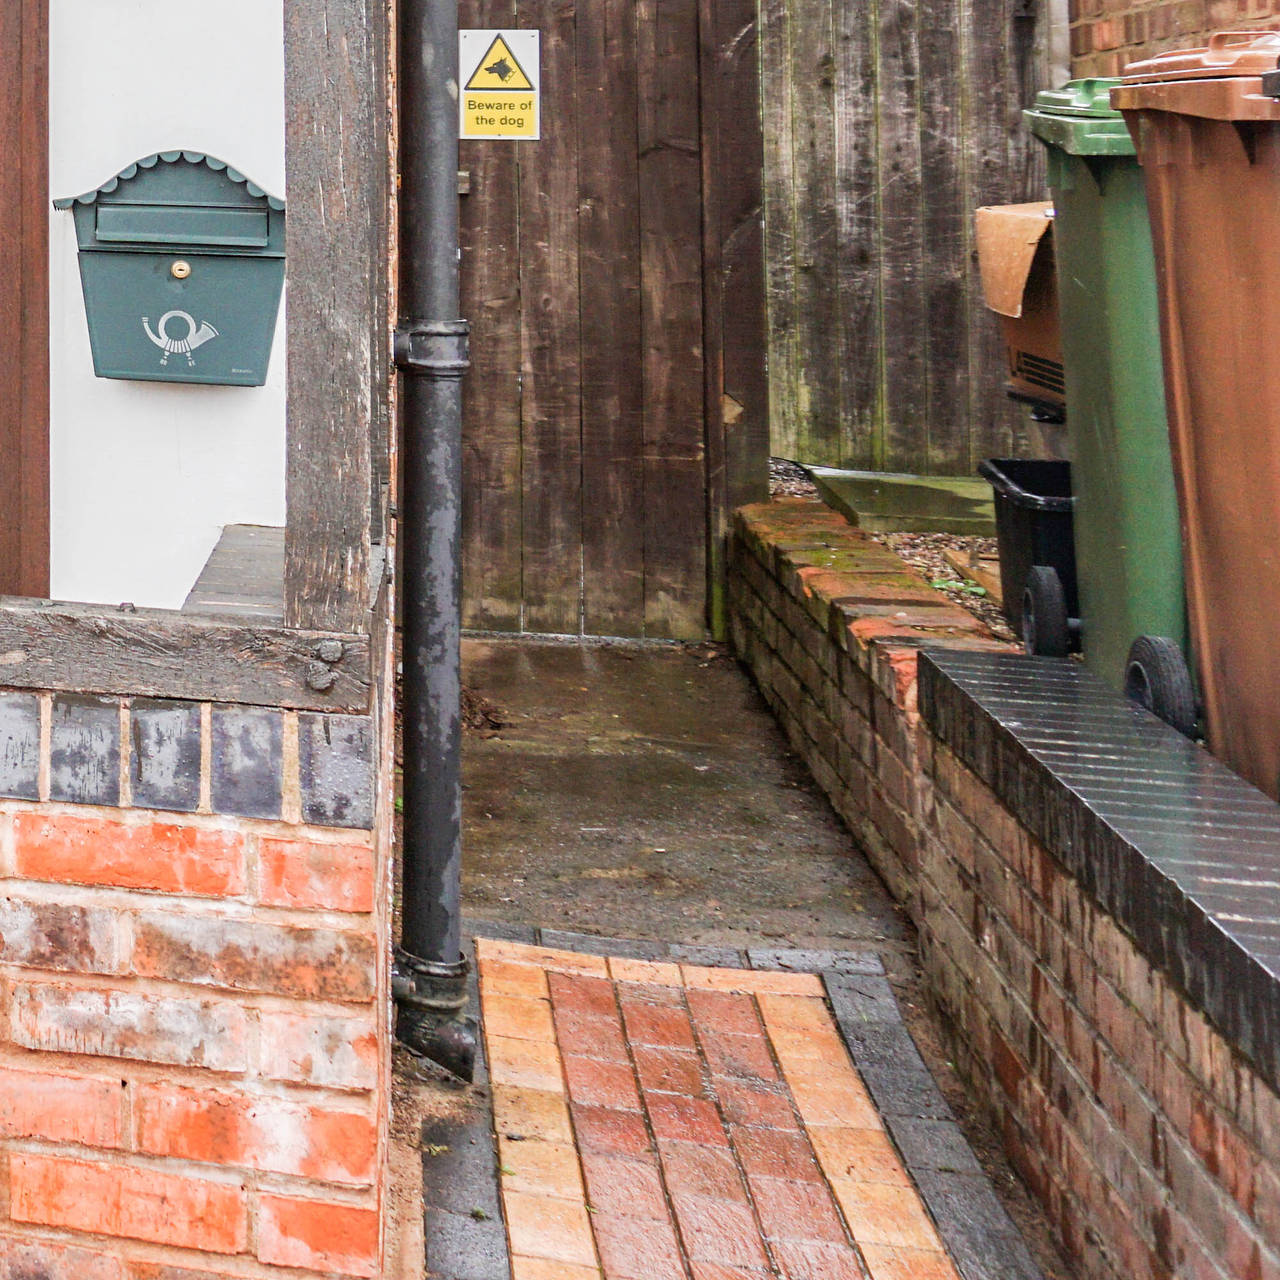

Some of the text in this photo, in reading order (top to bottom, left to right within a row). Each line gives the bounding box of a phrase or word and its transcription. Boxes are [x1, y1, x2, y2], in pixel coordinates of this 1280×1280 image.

[468, 100, 533, 111] Beware of
[475, 114, 524, 128] the dog
